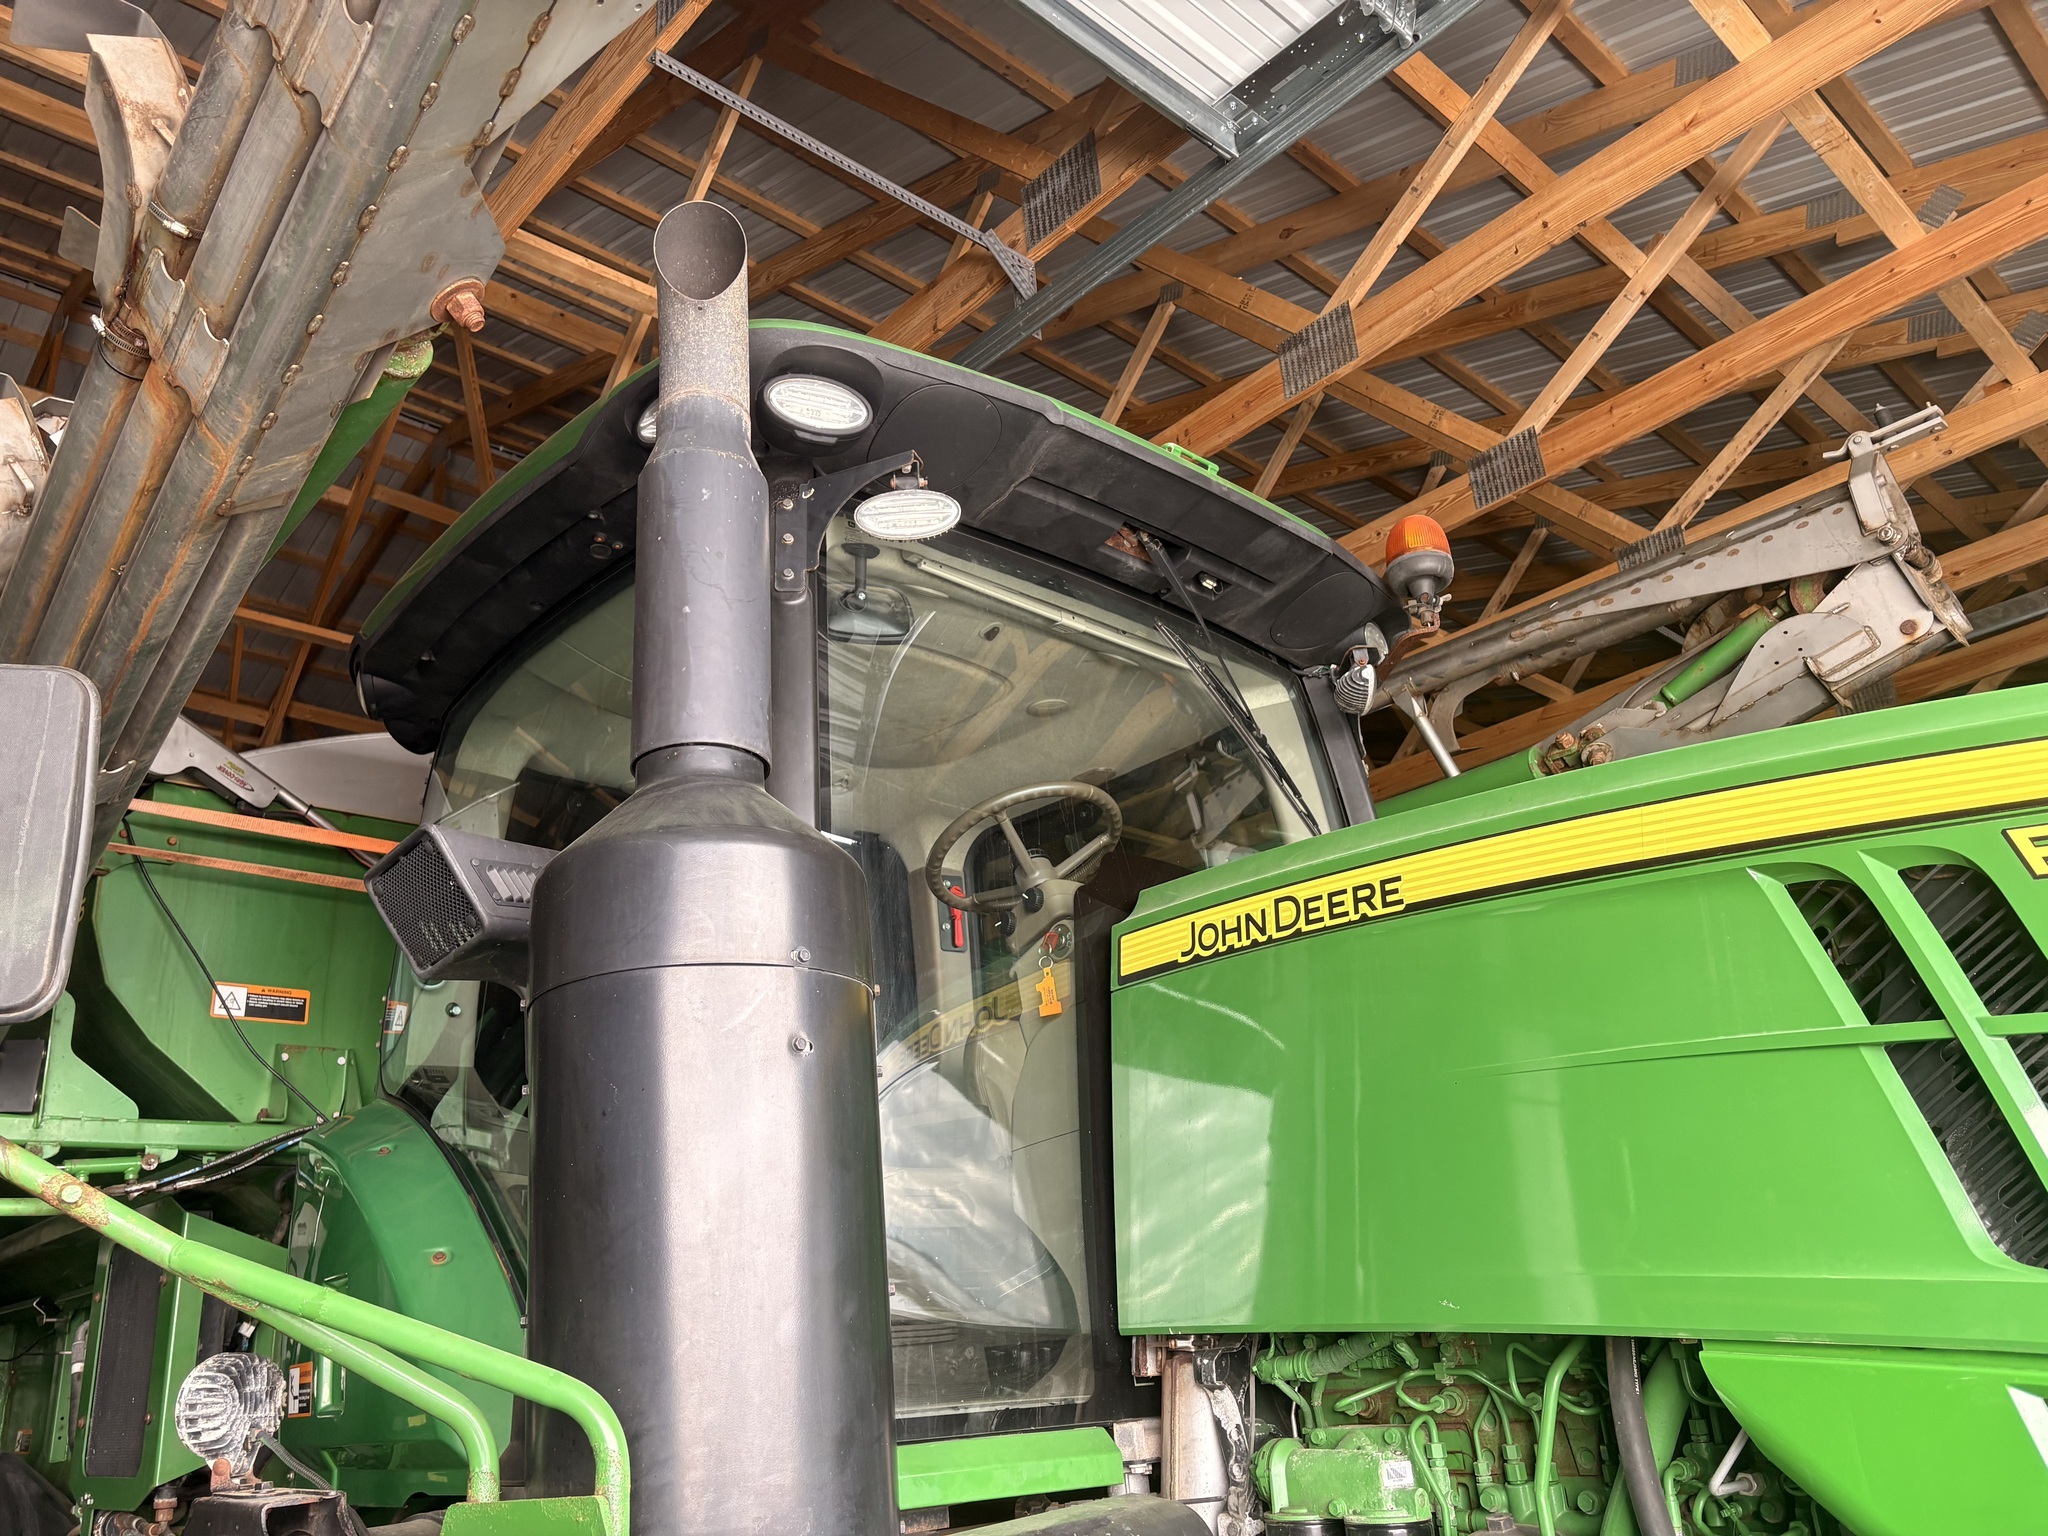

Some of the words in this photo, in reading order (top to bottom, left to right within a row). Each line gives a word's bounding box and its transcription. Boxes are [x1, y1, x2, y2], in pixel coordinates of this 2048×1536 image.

[1180, 908, 1268, 958] JOHN
[1272, 875, 1405, 932] DEERE
[267, 988, 293, 996] WARNING
